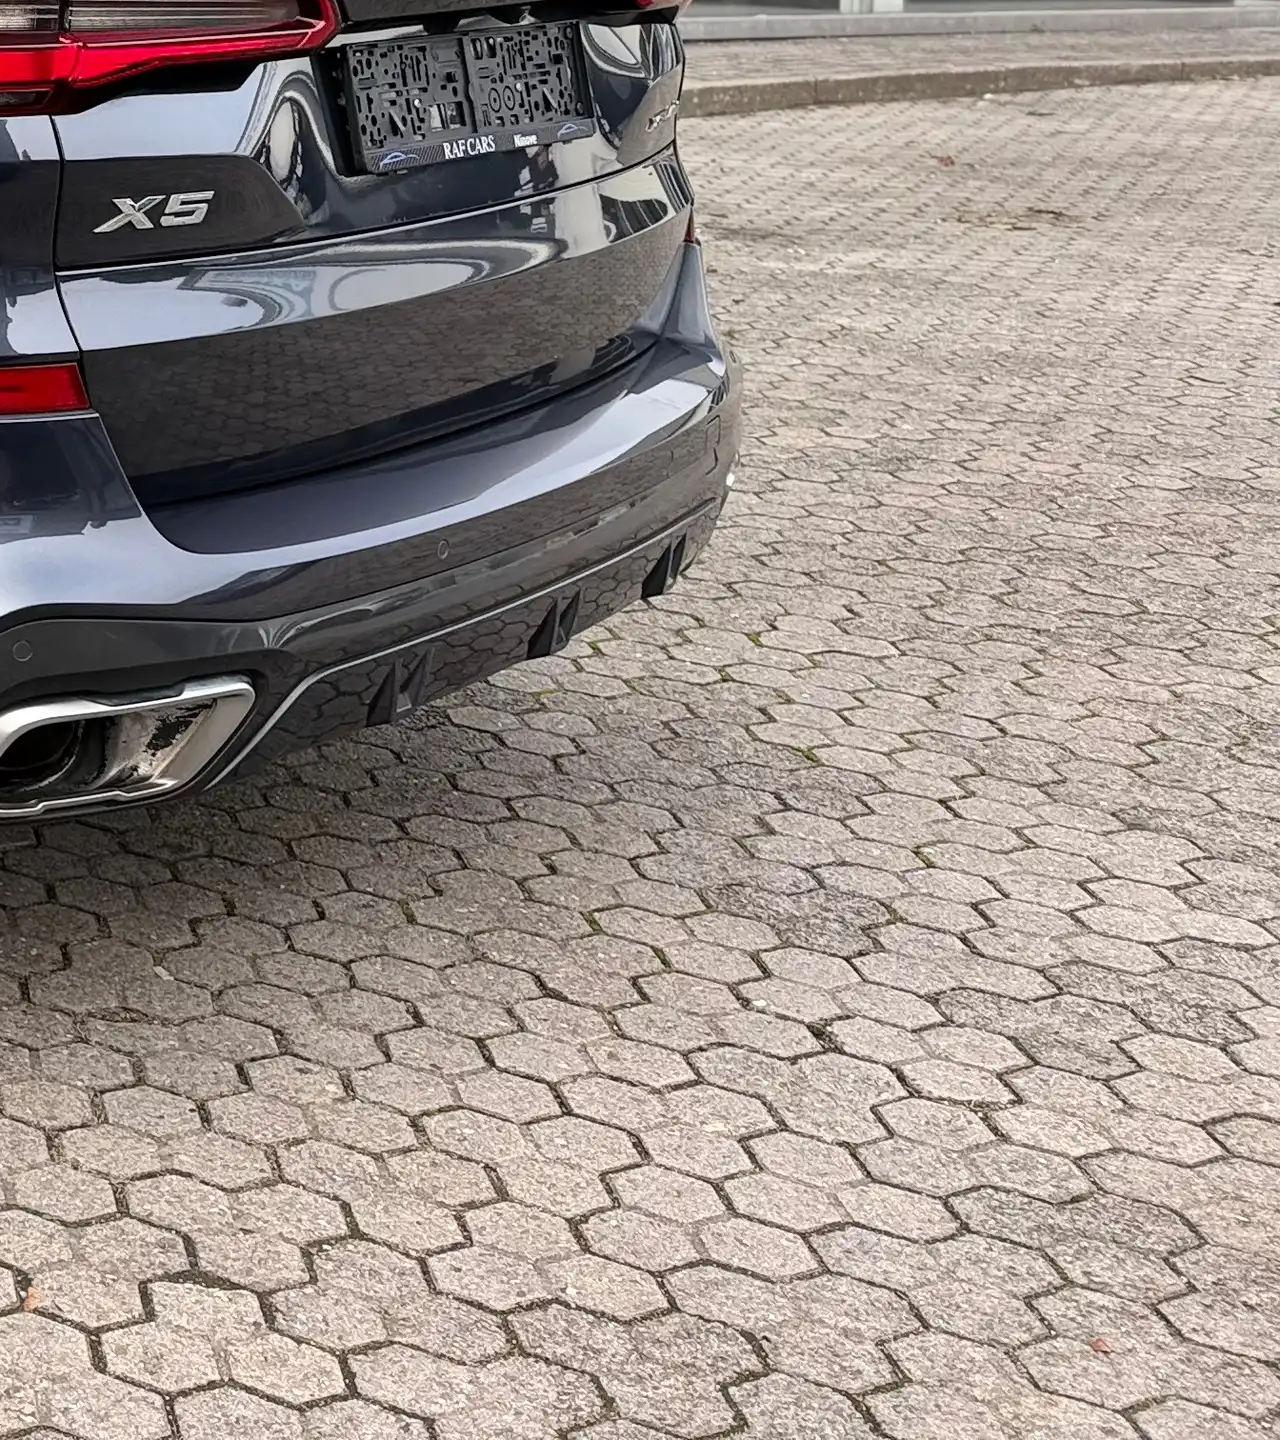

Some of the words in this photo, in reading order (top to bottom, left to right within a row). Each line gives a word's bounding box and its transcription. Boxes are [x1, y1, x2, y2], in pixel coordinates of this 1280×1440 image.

[443, 139, 466, 160] RAF
[467, 135, 496, 156] CARS
[93, 191, 215, 233] X5
